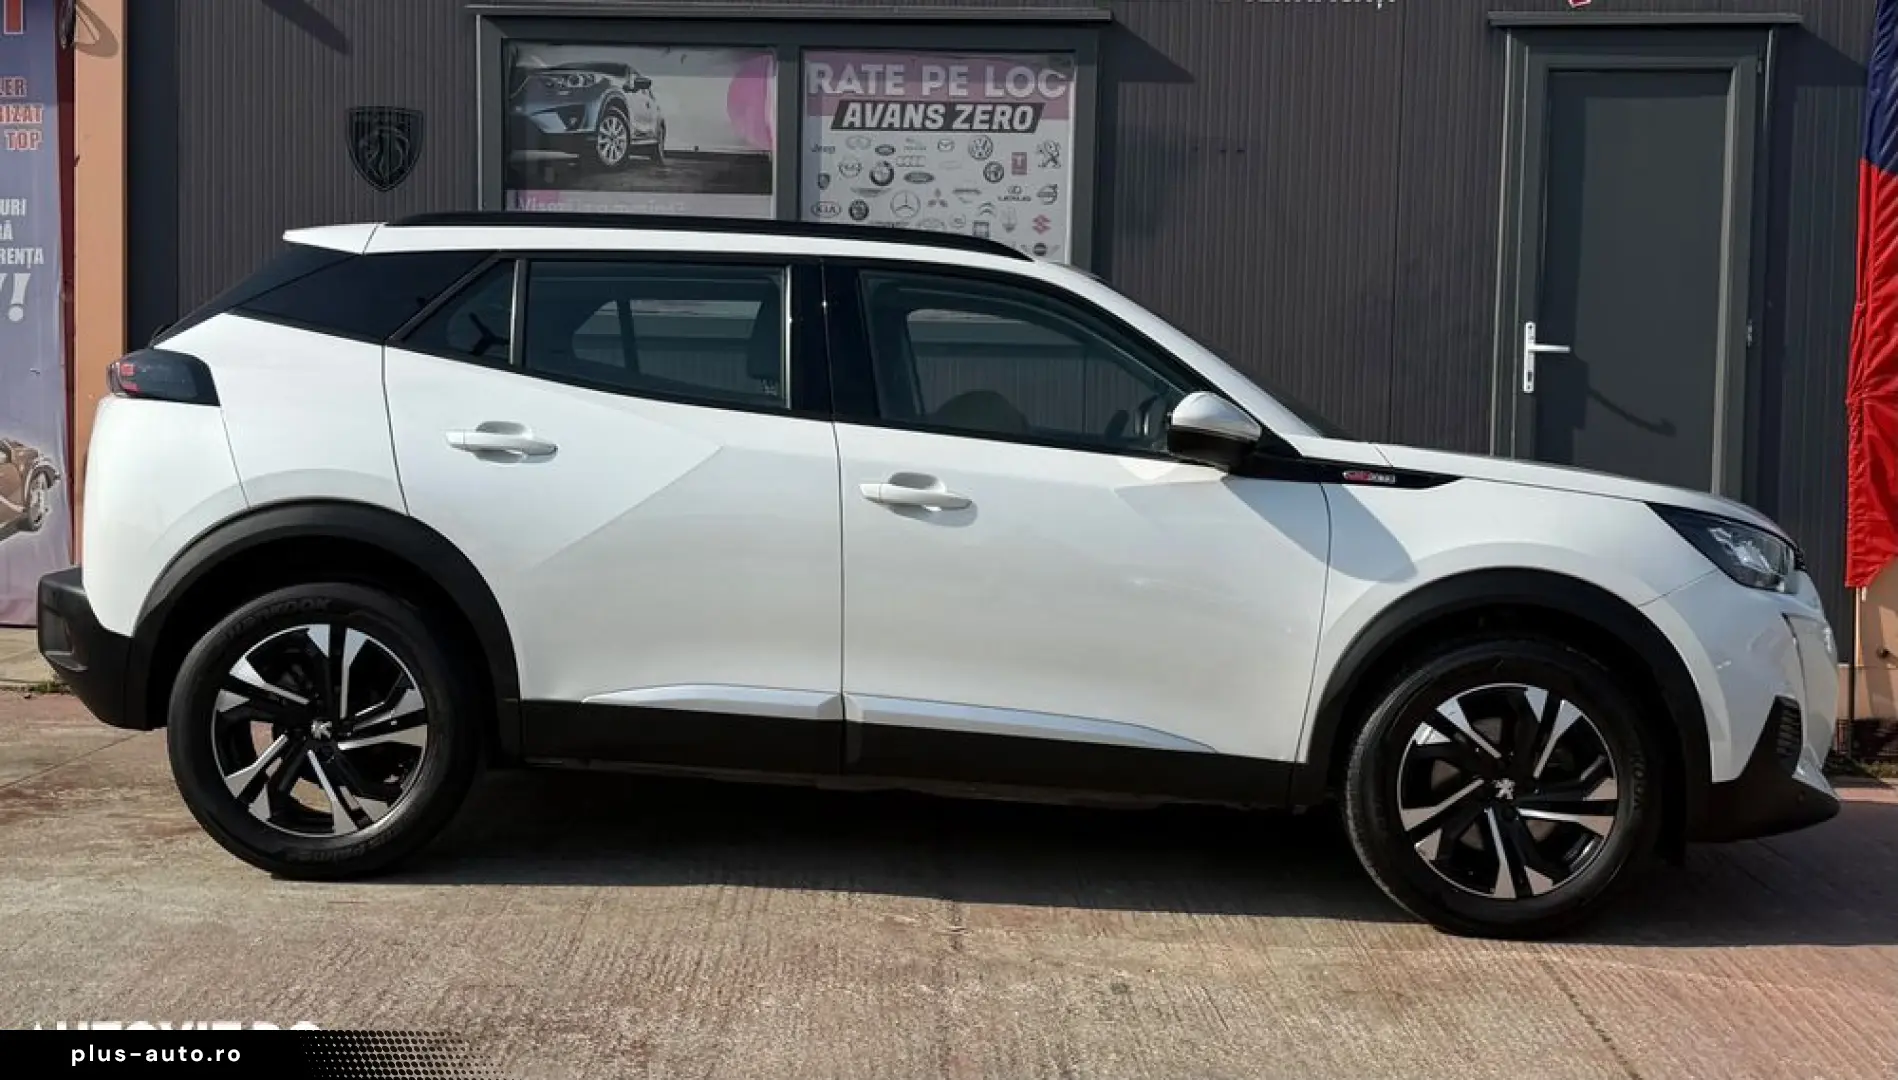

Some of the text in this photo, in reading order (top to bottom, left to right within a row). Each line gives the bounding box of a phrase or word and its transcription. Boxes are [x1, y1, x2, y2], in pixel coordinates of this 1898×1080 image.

[807, 60, 1067, 99] RATE PE LOC
[841, 102, 1035, 131] AVANS ZERO
[5, 130, 41, 150] TOP
